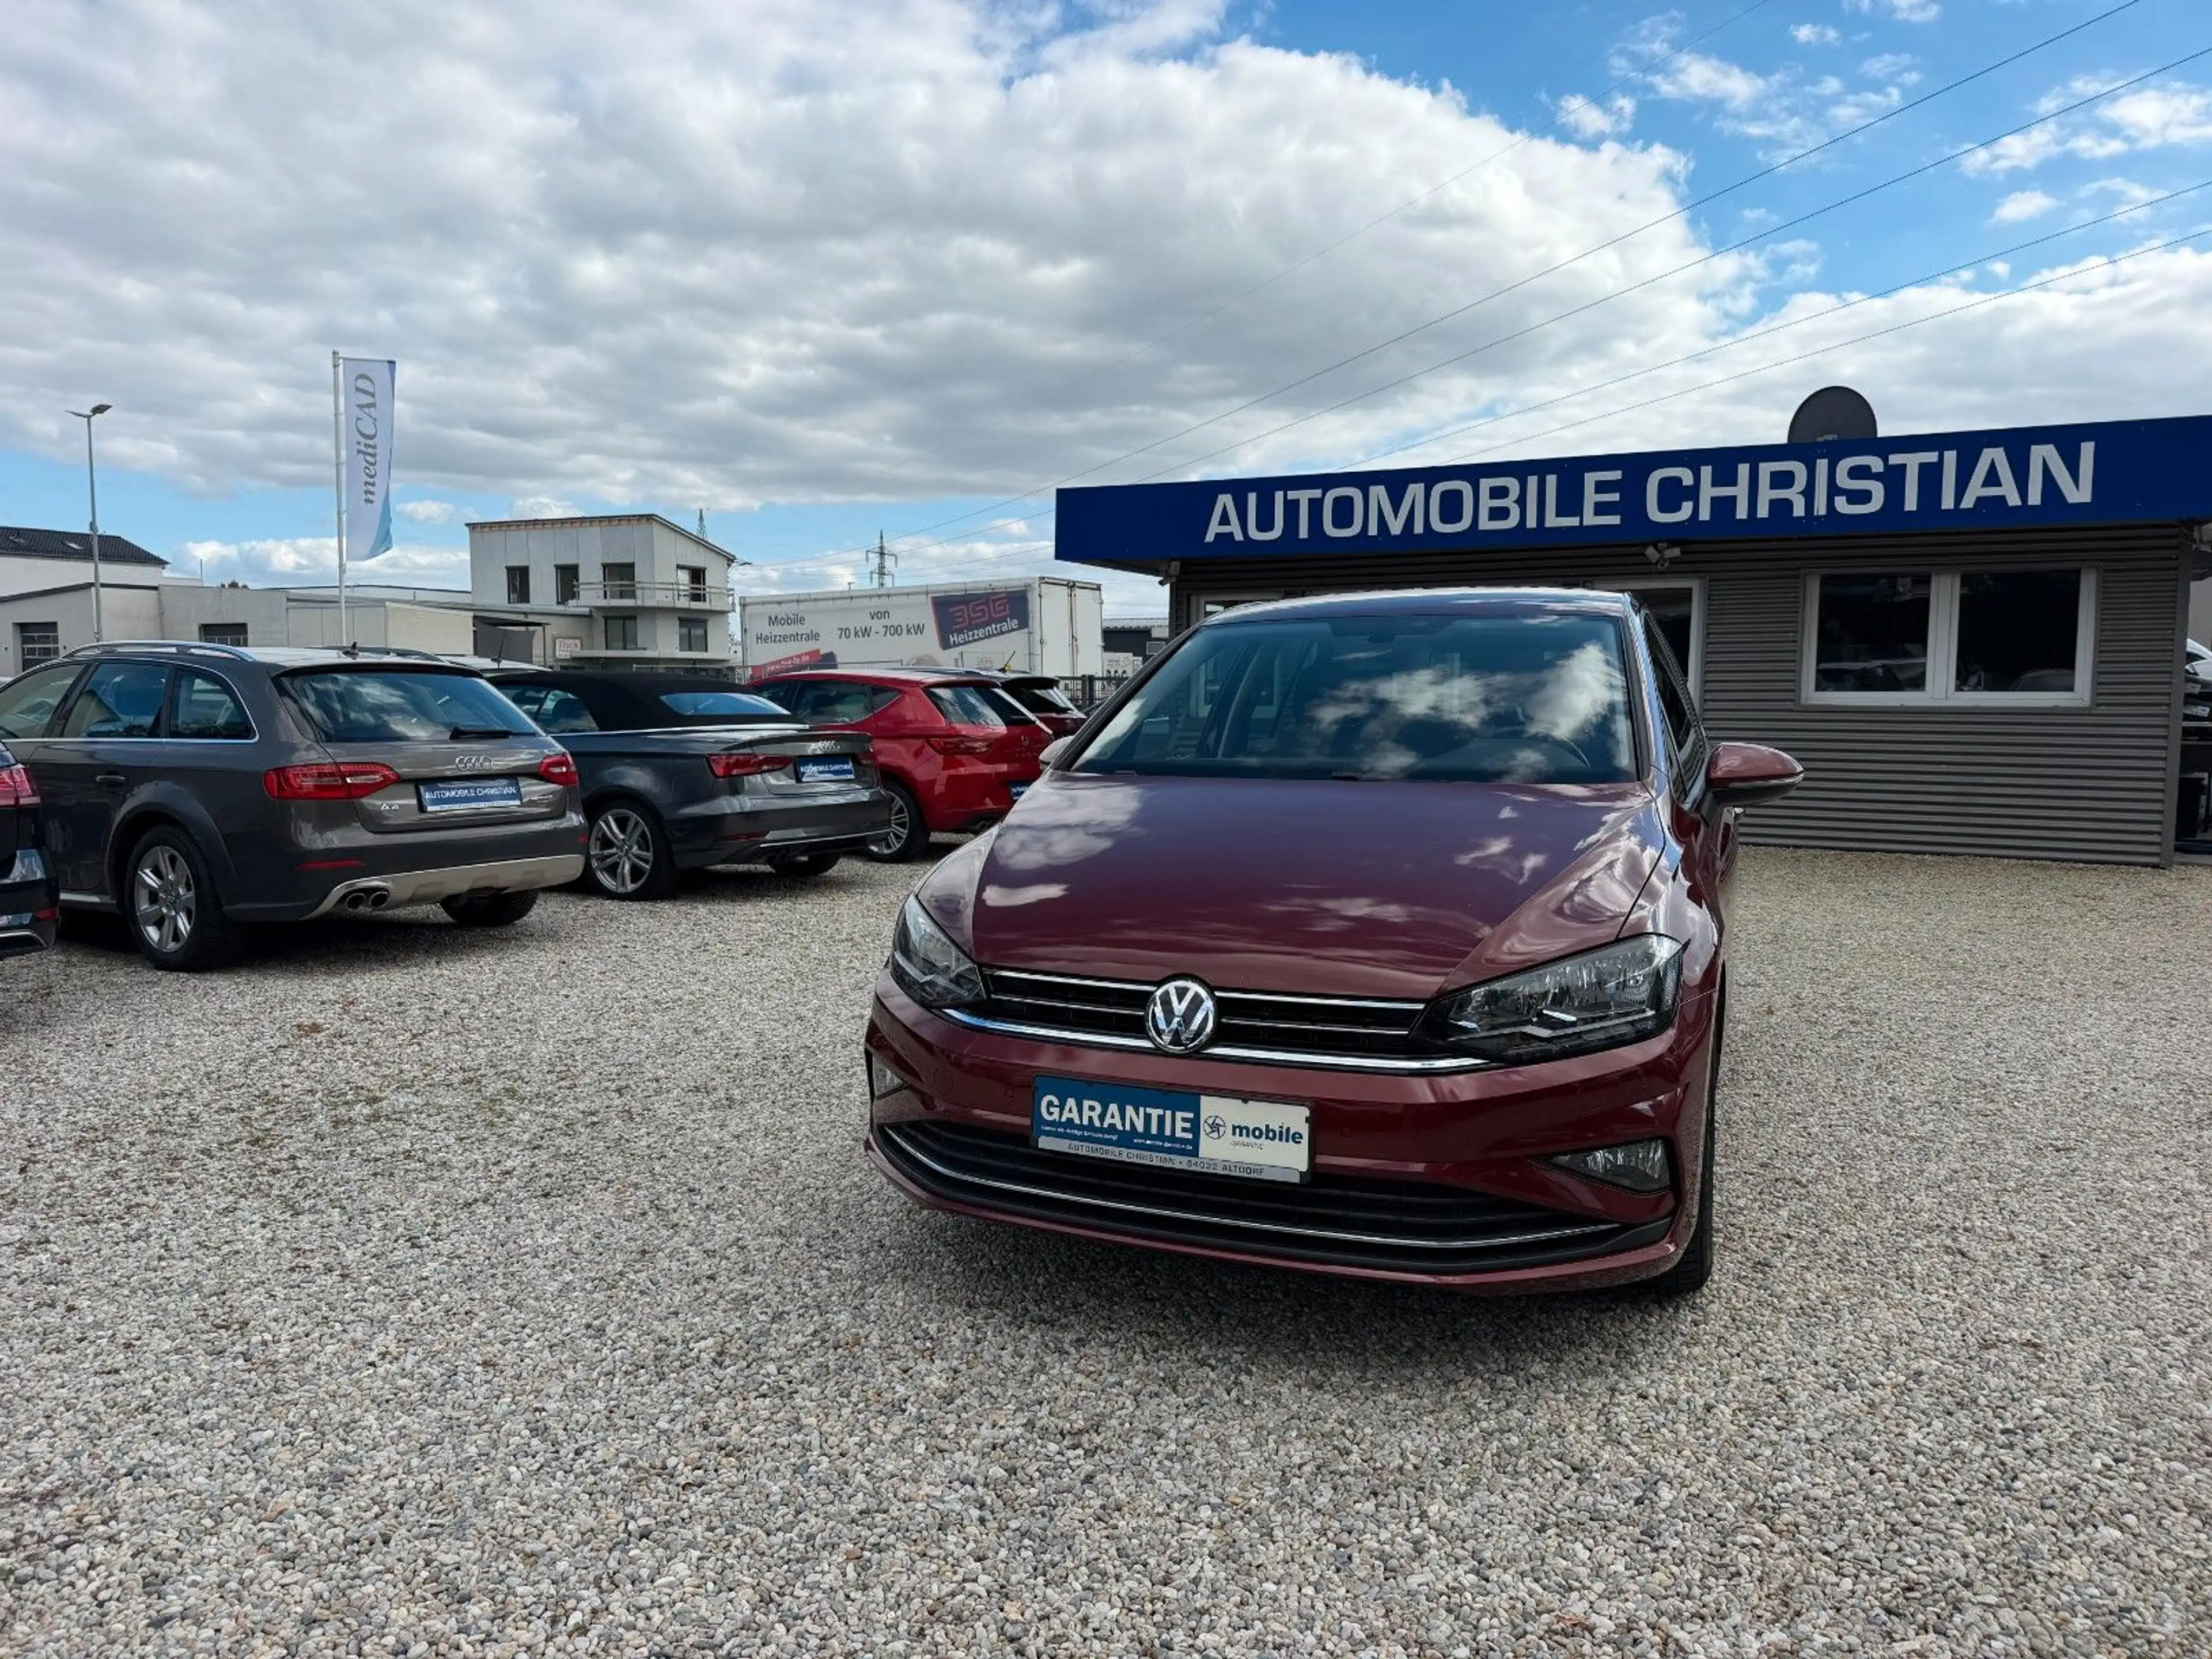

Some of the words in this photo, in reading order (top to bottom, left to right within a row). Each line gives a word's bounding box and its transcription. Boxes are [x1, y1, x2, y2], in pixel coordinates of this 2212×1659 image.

[354, 373, 378, 506] mediCAD
[1204, 467, 1623, 544] AUTOMOBILE
[1646, 441, 2096, 524] CHRISTIAN
[768, 614, 805, 627] Mobile
[869, 611, 890, 620] von
[755, 630, 820, 644] Heizzentrale
[838, 627, 851, 639] 70
[853, 626, 873, 639] kW
[882, 624, 903, 638] 700
[906, 623, 925, 637] kW
[949, 618, 1018, 646] Heizzentrale
[1040, 1094, 1194, 1139] GARANTIE
[1231, 1122, 1304, 1145] mobile
[1068, 1142, 1123, 1158] AUTOMOBILE
[1127, 1152, 1175, 1165] CHRISTIAN
